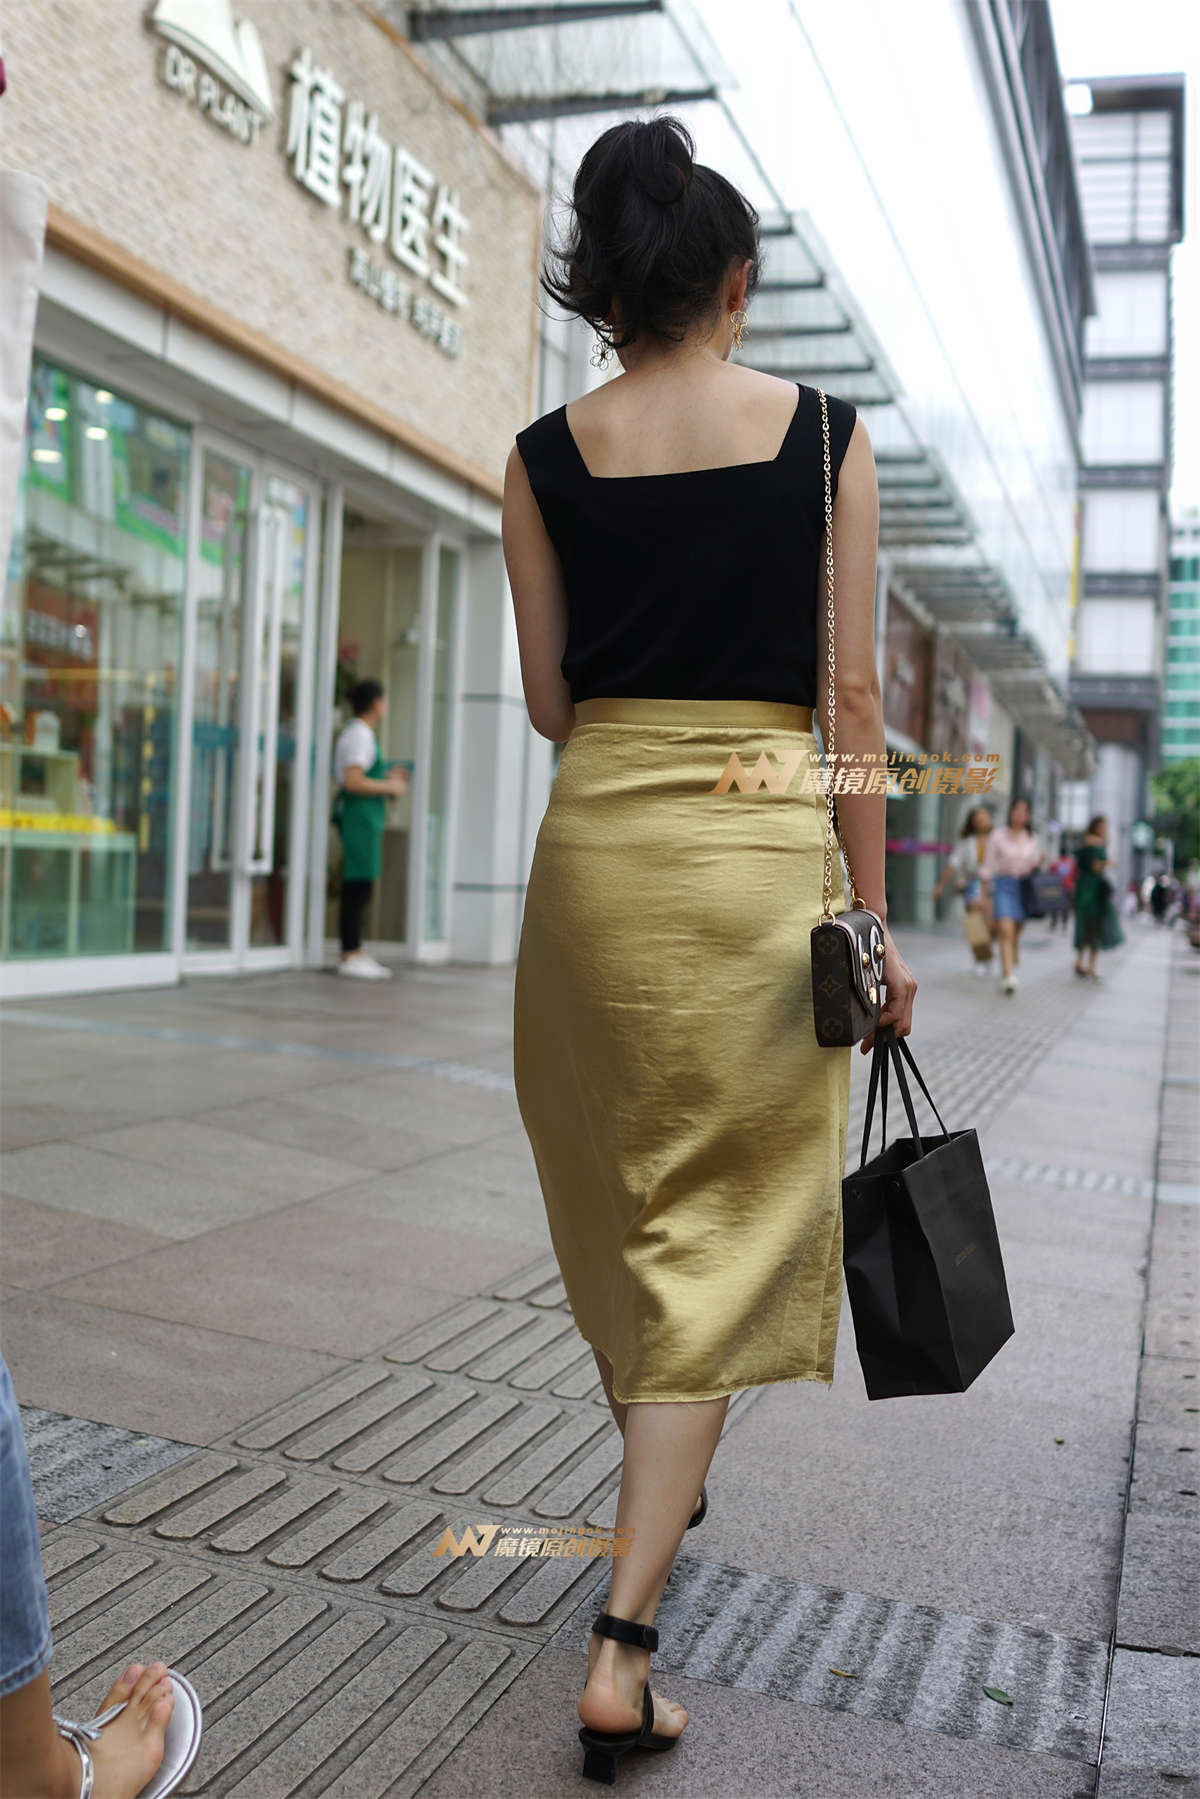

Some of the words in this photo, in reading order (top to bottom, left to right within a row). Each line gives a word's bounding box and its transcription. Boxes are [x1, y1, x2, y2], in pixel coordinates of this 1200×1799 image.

[200, 73, 263, 144] PLANT
[286, 48, 469, 307] 植物医生
